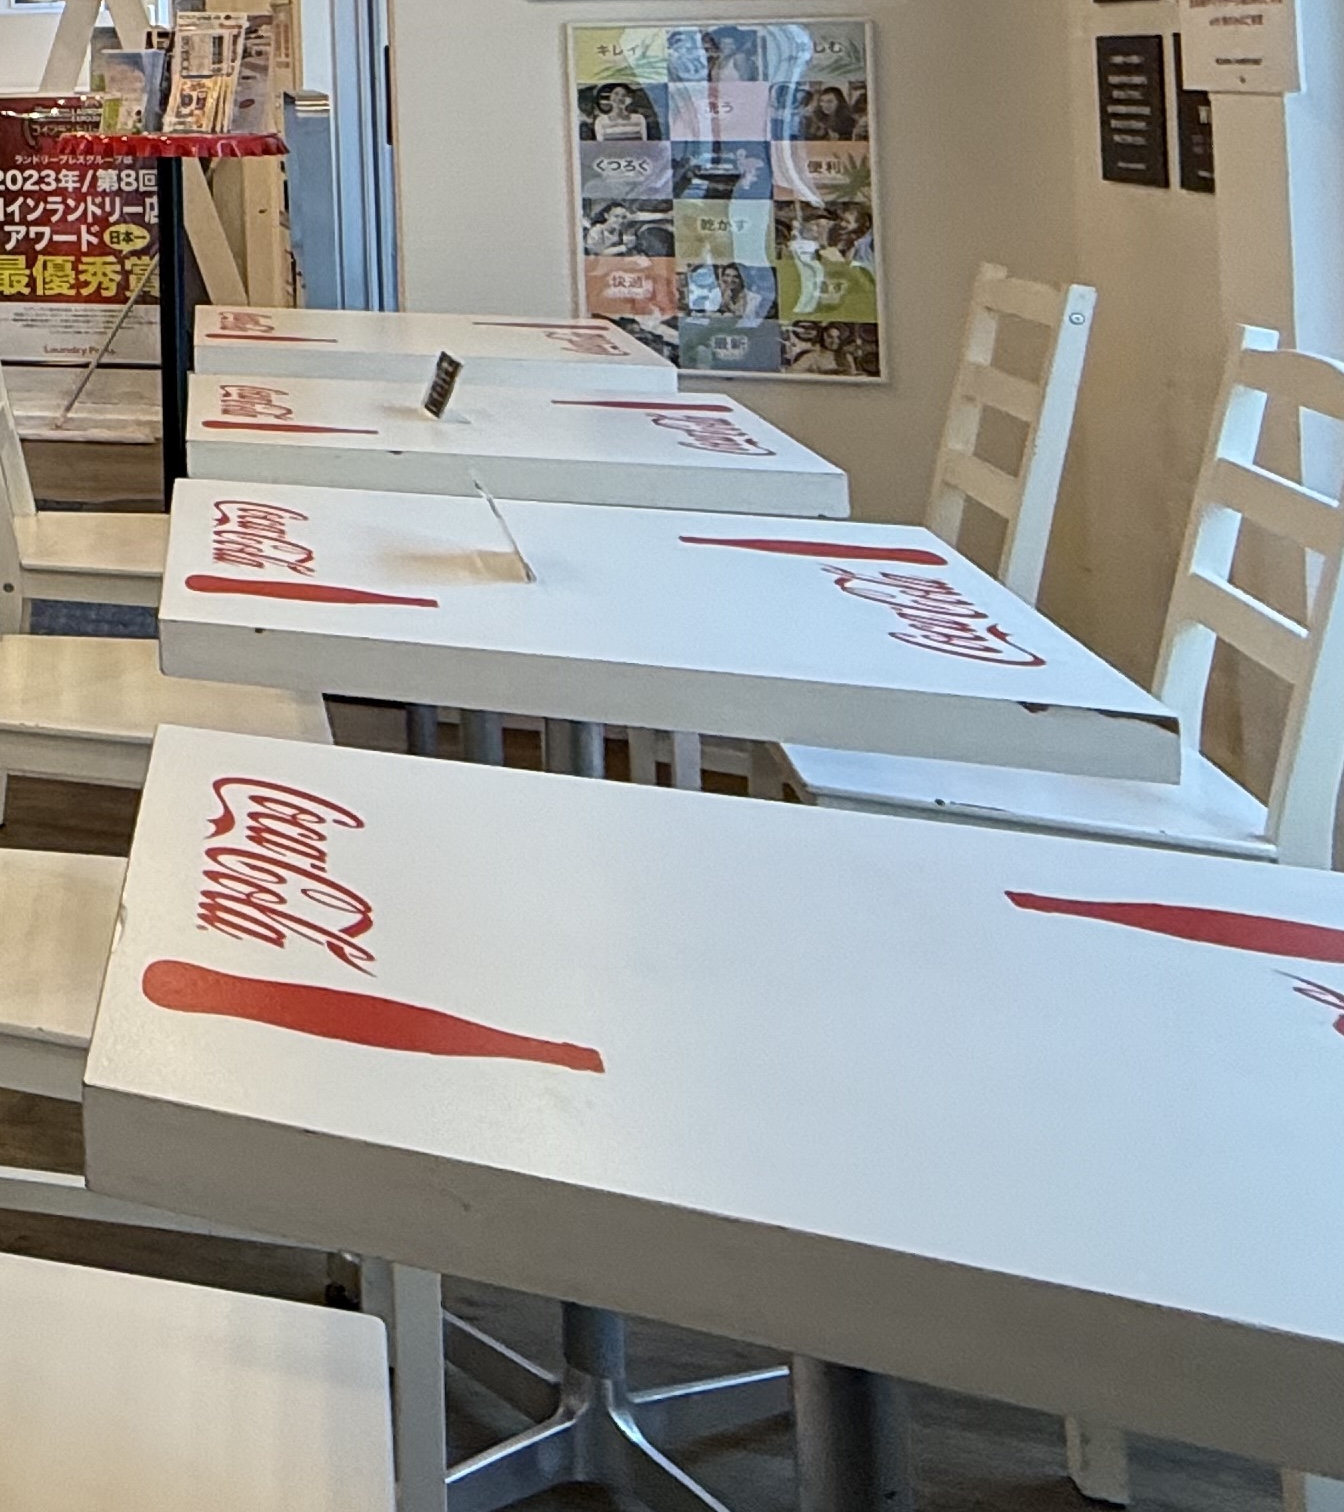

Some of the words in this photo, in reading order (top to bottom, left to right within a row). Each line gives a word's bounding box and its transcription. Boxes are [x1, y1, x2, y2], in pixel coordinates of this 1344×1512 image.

[595, 159, 650, 173] くつろぐ
[807, 160, 843, 174] 便利
[3, 224, 100, 252] アワード
[109, 230, 148, 245] 日本一
[197, 776, 378, 978] Coca-Cola
